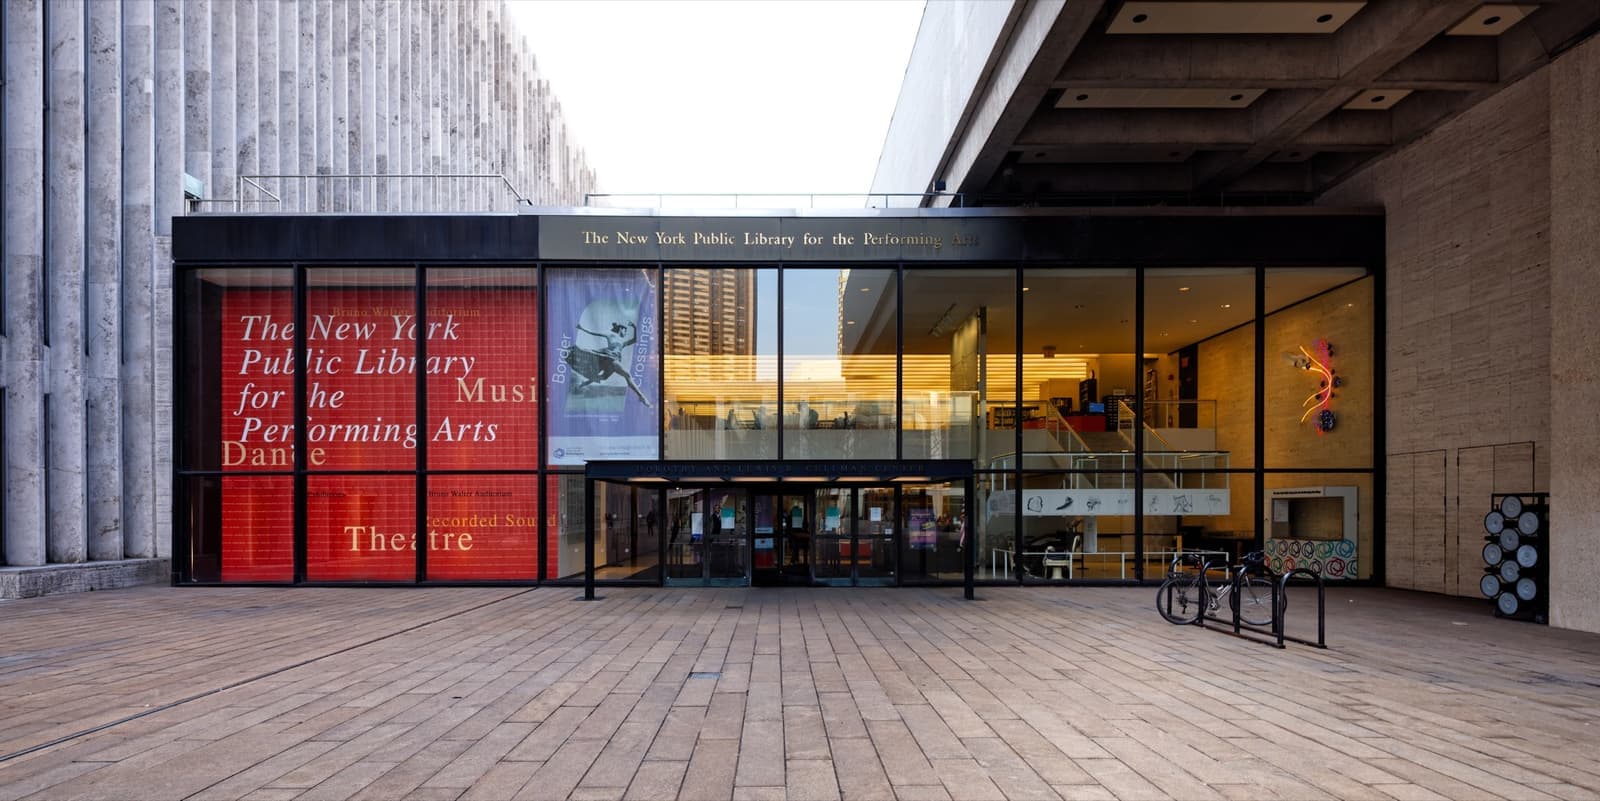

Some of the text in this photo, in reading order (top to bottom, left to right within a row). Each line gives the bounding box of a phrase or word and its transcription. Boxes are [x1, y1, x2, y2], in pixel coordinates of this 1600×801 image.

[582, 231, 609, 244] The
[616, 231, 649, 244] New
[655, 231, 686, 245] York
[693, 232, 735, 245] Public
[743, 232, 794, 249] Library
[803, 232, 824, 245] for
[832, 233, 855, 245] the
[863, 232, 943, 248] Performing
[240, 314, 294, 341] The
[308, 314, 377, 341] New
[552, 334, 572, 384] Border
[233, 382, 345, 416] for he
[456, 377, 549, 403] Musi
[239, 416, 498, 449] Perorming Arts
[222, 441, 326, 466] Dane
[427, 514, 557, 528] ecorded Soud
